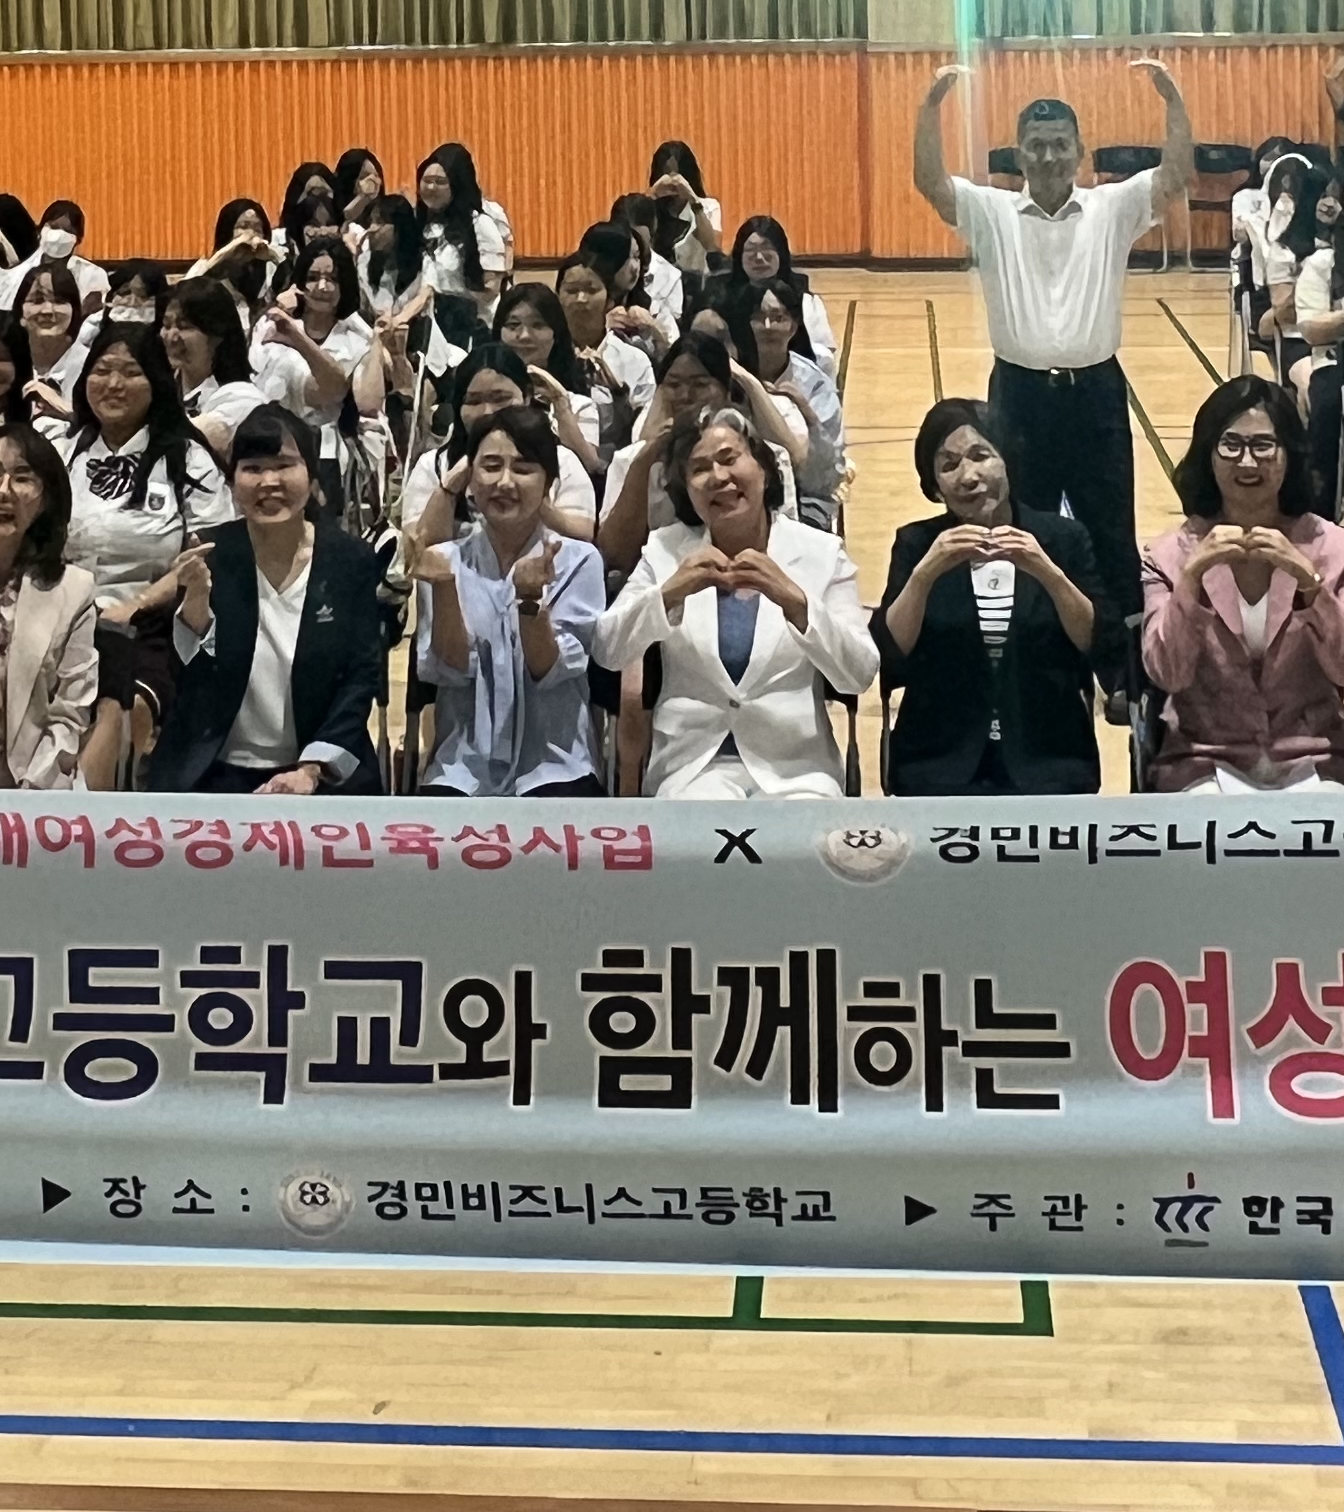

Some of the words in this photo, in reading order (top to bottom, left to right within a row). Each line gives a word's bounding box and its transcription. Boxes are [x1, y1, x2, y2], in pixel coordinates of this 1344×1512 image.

[580, 946, 1072, 1113] 함께하는
[102, 1175, 147, 1219] 장
[171, 1178, 215, 1215] 소
[366, 1179, 837, 1228] 경민비즈니스고등학교
[969, 1193, 1016, 1233] 주
[1041, 1193, 1089, 1233] 관
